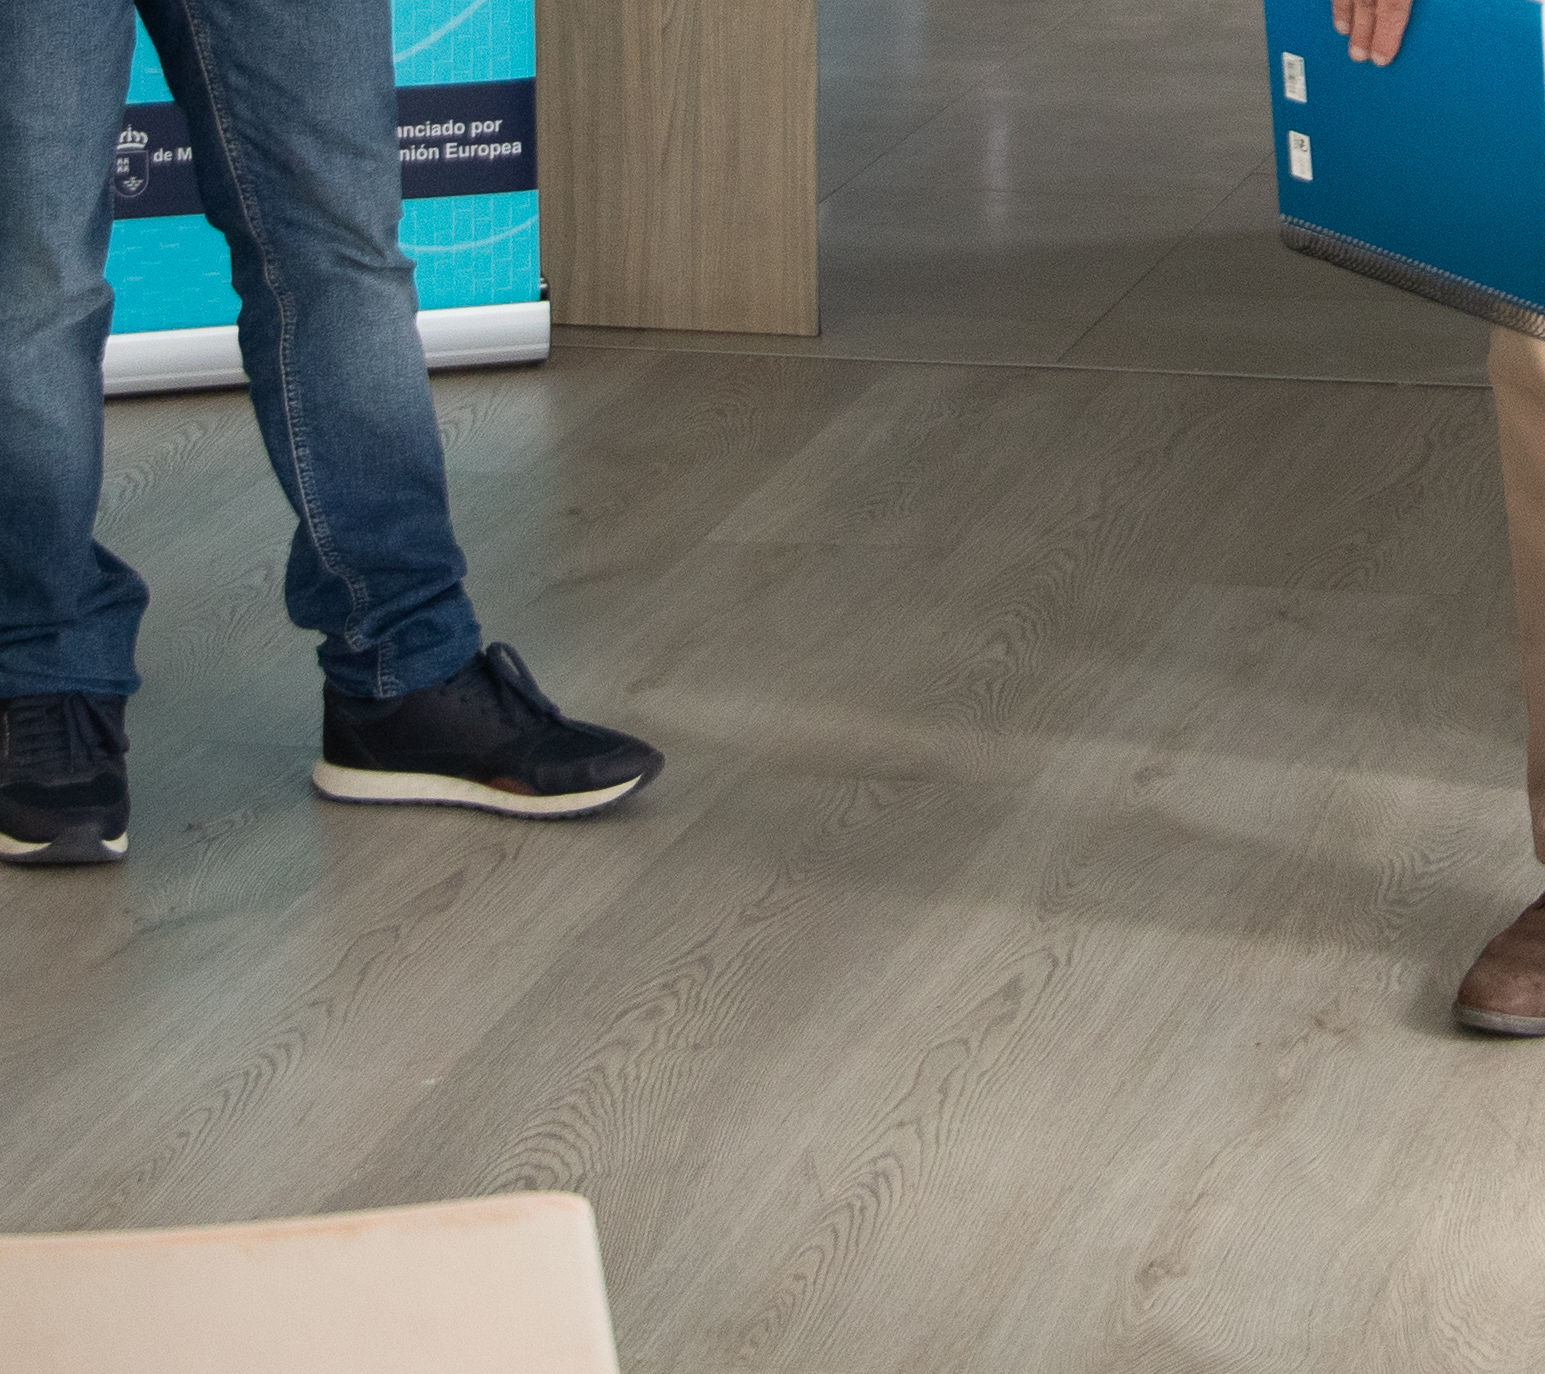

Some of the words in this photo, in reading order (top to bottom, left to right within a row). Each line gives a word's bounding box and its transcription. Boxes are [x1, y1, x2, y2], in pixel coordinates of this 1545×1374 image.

[471, 119, 503, 138] por
[153, 147, 173, 163] de
[399, 143, 440, 162] nión
[445, 141, 522, 160] Europea
